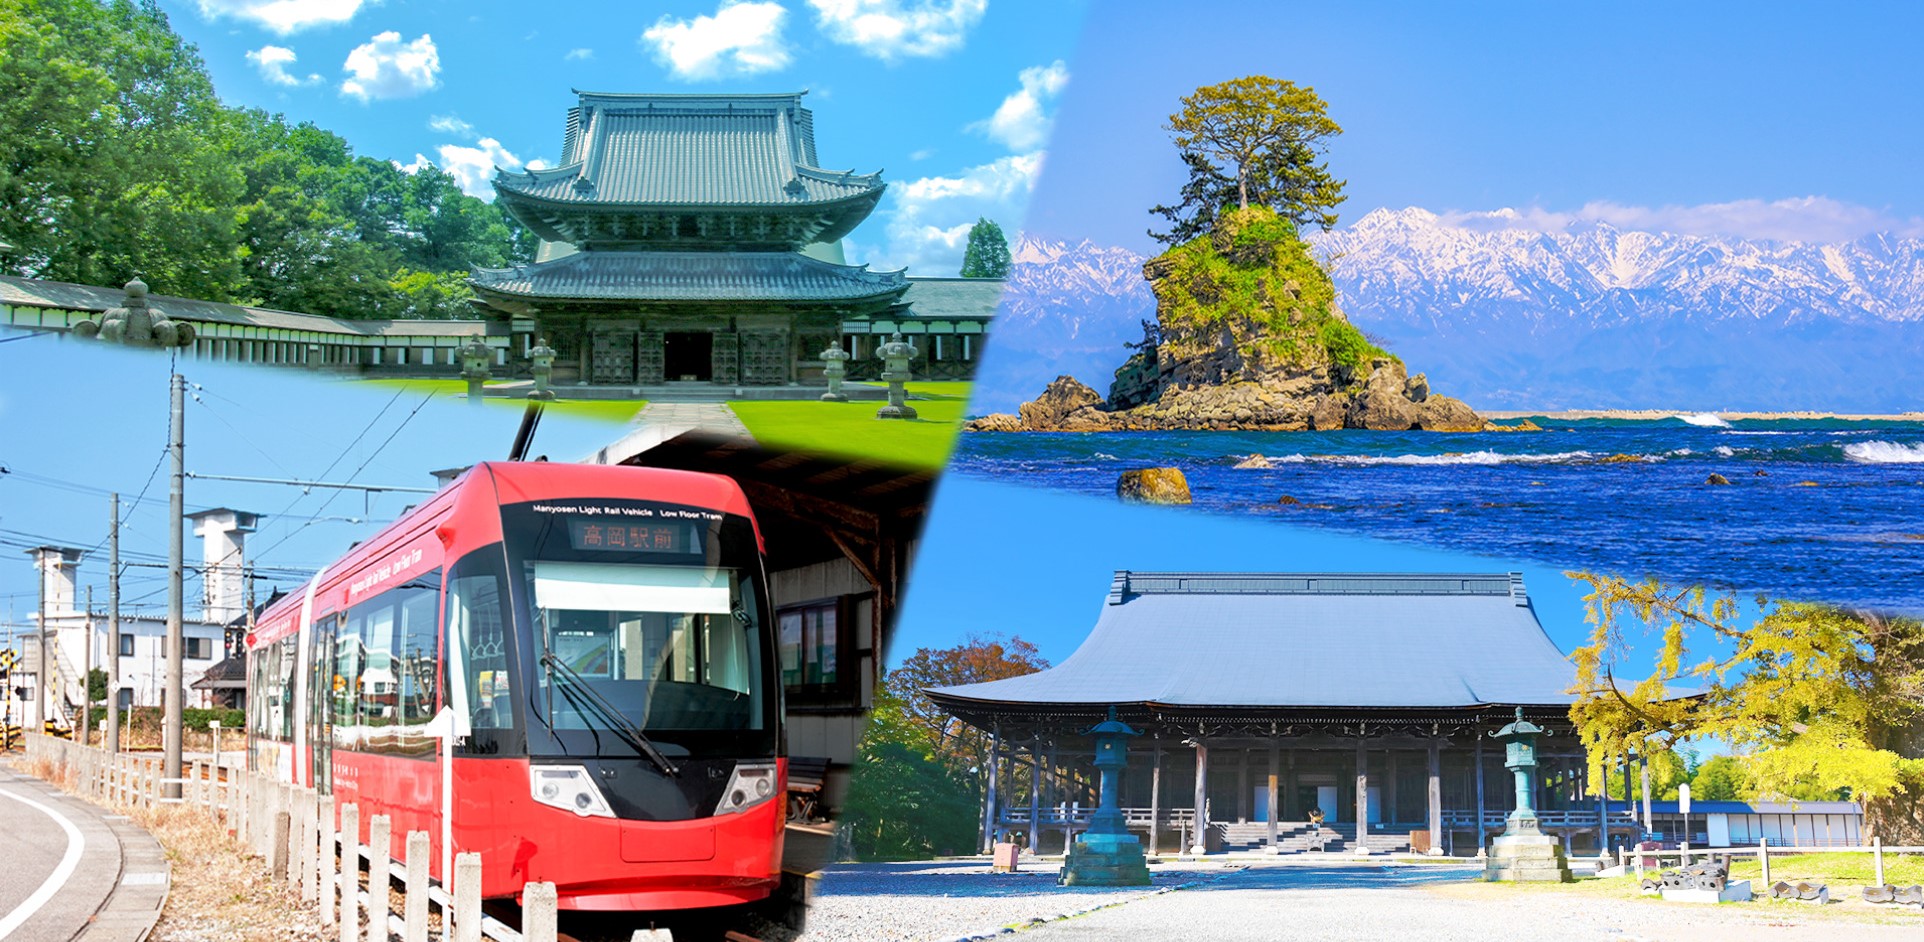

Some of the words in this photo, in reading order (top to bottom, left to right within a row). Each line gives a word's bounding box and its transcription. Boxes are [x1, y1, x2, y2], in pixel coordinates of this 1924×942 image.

[533, 504, 577, 514] Manyosen
[579, 505, 602, 515] Light
[604, 506, 620, 515] Rail
[621, 507, 653, 516] Vehicle
[660, 509, 677, 517] Low
[679, 510, 700, 519] Floor
[701, 511, 723, 520] Tram
[584, 525, 673, 549] 高岡駅前
